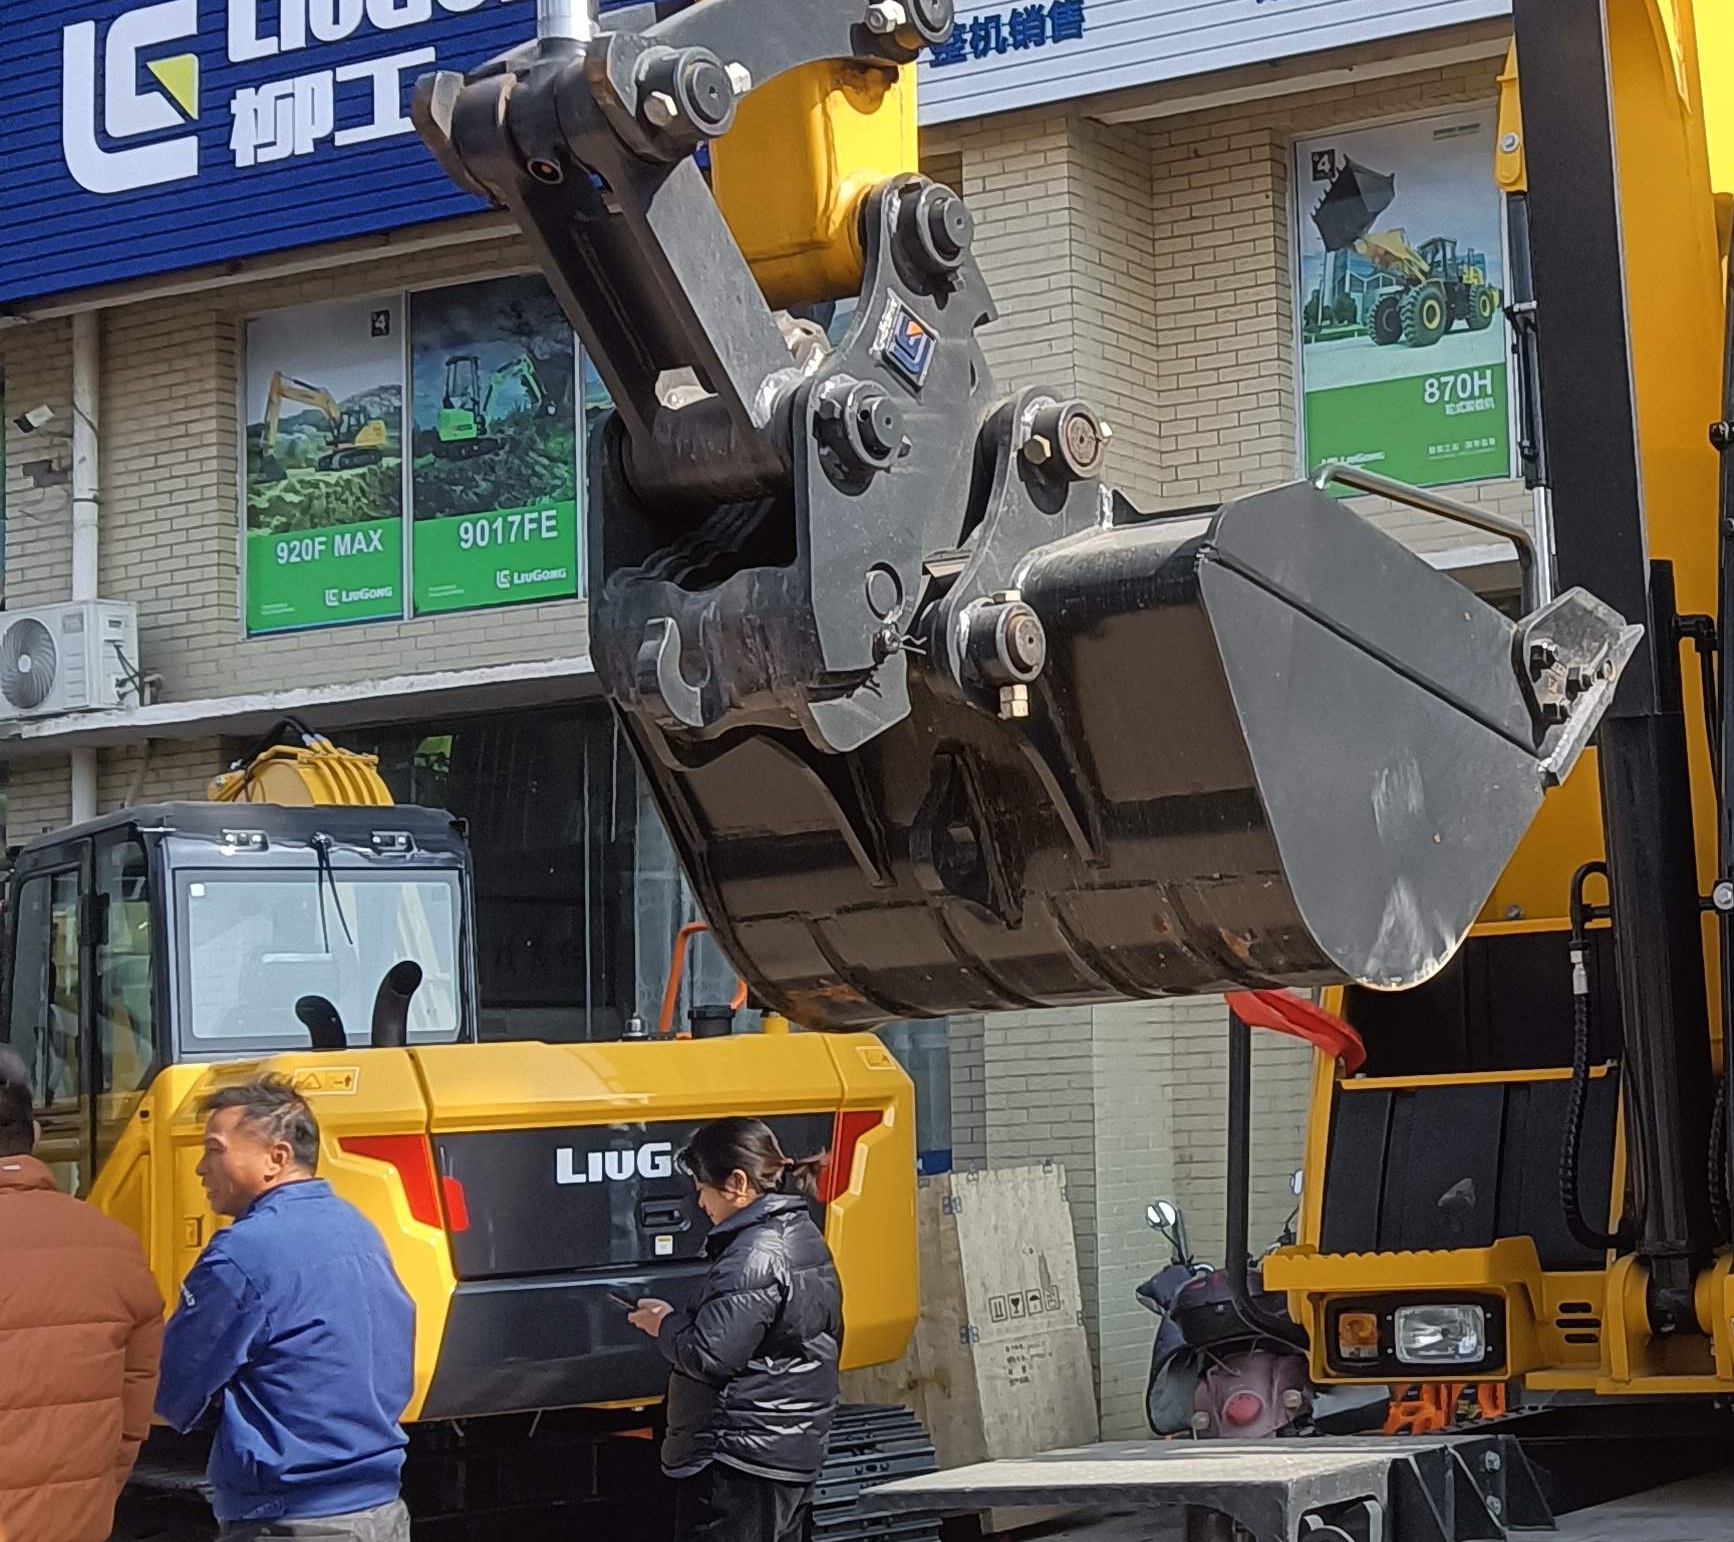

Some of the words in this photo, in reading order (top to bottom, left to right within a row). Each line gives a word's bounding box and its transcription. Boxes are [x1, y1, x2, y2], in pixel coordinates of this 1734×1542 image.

[230, 46, 436, 167] 柳工
[1424, 369, 1493, 404] 870H
[277, 537, 327, 565] 920F
[333, 528, 385, 558] MAX
[459, 509, 559, 549] 9017FE
